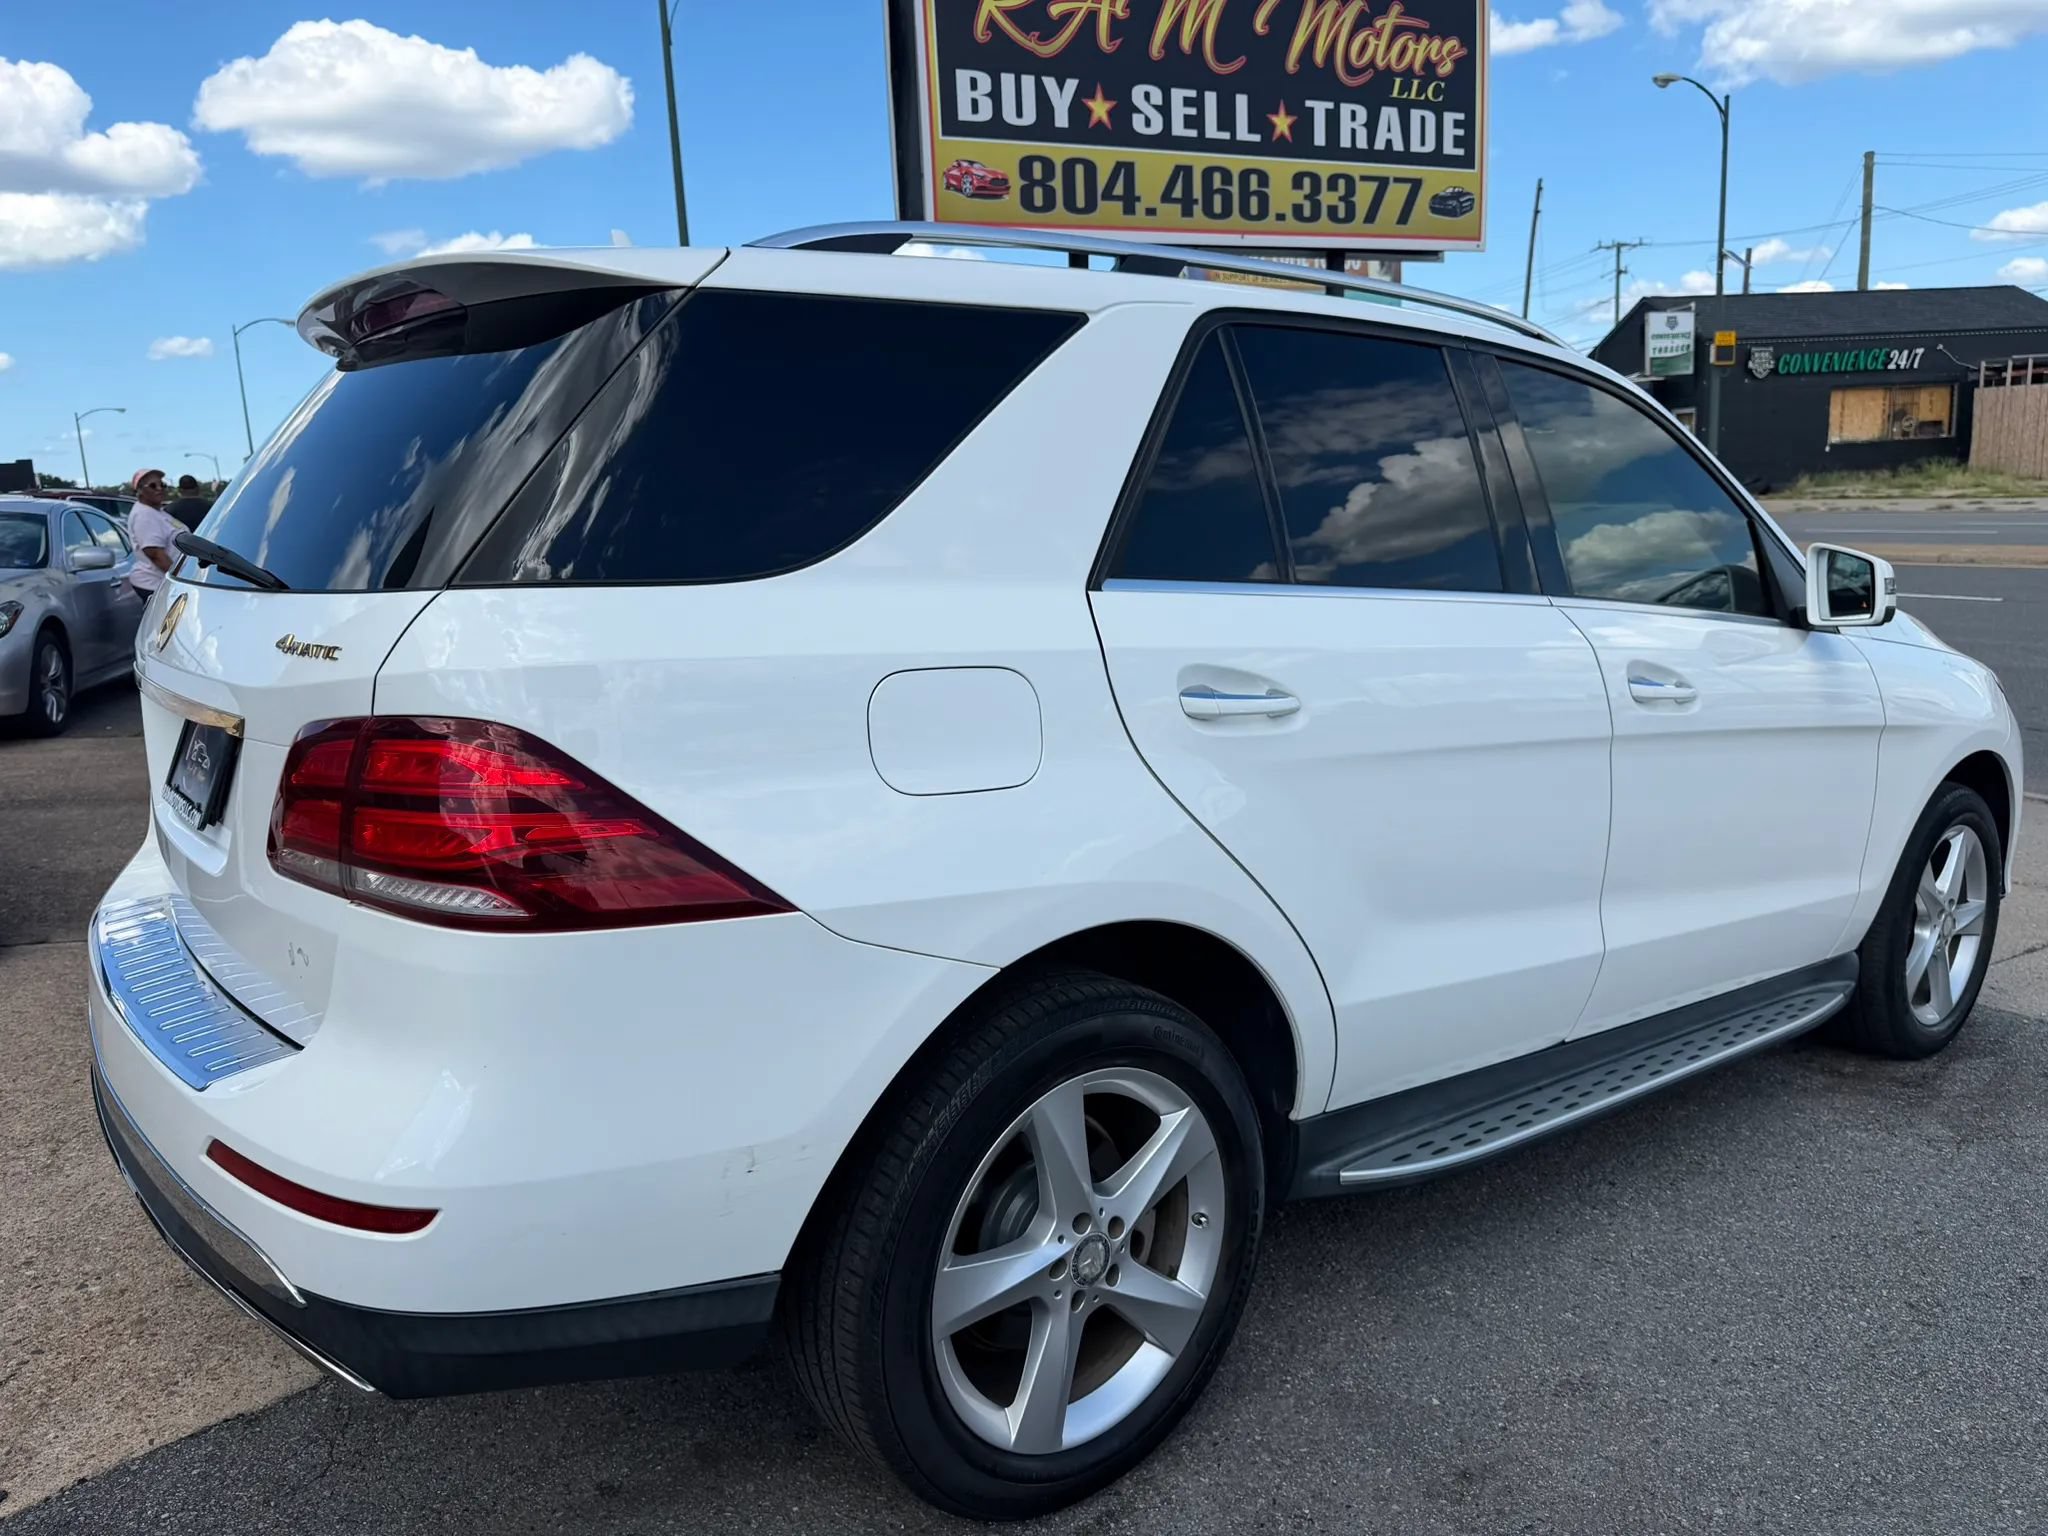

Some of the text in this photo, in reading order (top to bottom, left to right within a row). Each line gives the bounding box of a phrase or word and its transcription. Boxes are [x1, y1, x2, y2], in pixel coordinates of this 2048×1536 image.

[1253, 0, 1468, 87] Motors
[955, 68, 1466, 156] BUY SELL TRADE
[1390, 77, 1446, 102] LLC
[1018, 154, 1423, 226] 804.466.3377
[1778, 348, 1889, 375] CONVENIENCE
[1887, 347, 1926, 370] 24/7
